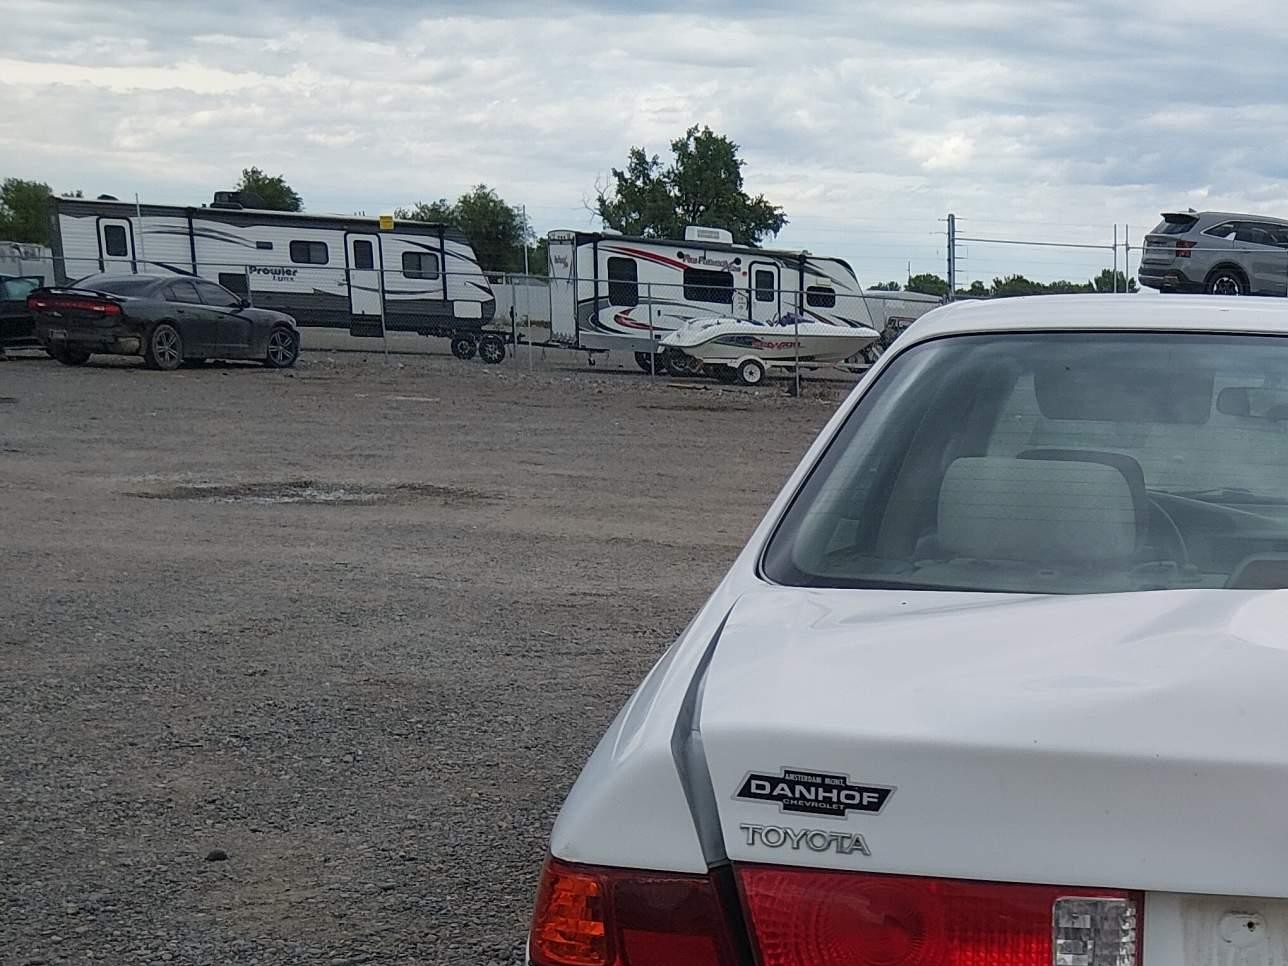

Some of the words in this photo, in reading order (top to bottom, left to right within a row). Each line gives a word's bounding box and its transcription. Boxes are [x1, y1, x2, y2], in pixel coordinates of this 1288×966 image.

[249, 265, 298, 276] Prowler
[785, 773, 822, 784] AMSTERDAM
[751, 780, 879, 805] DANHOF
[783, 798, 845, 810] CHEVROLET
[740, 823, 872, 856] TOYOTA
